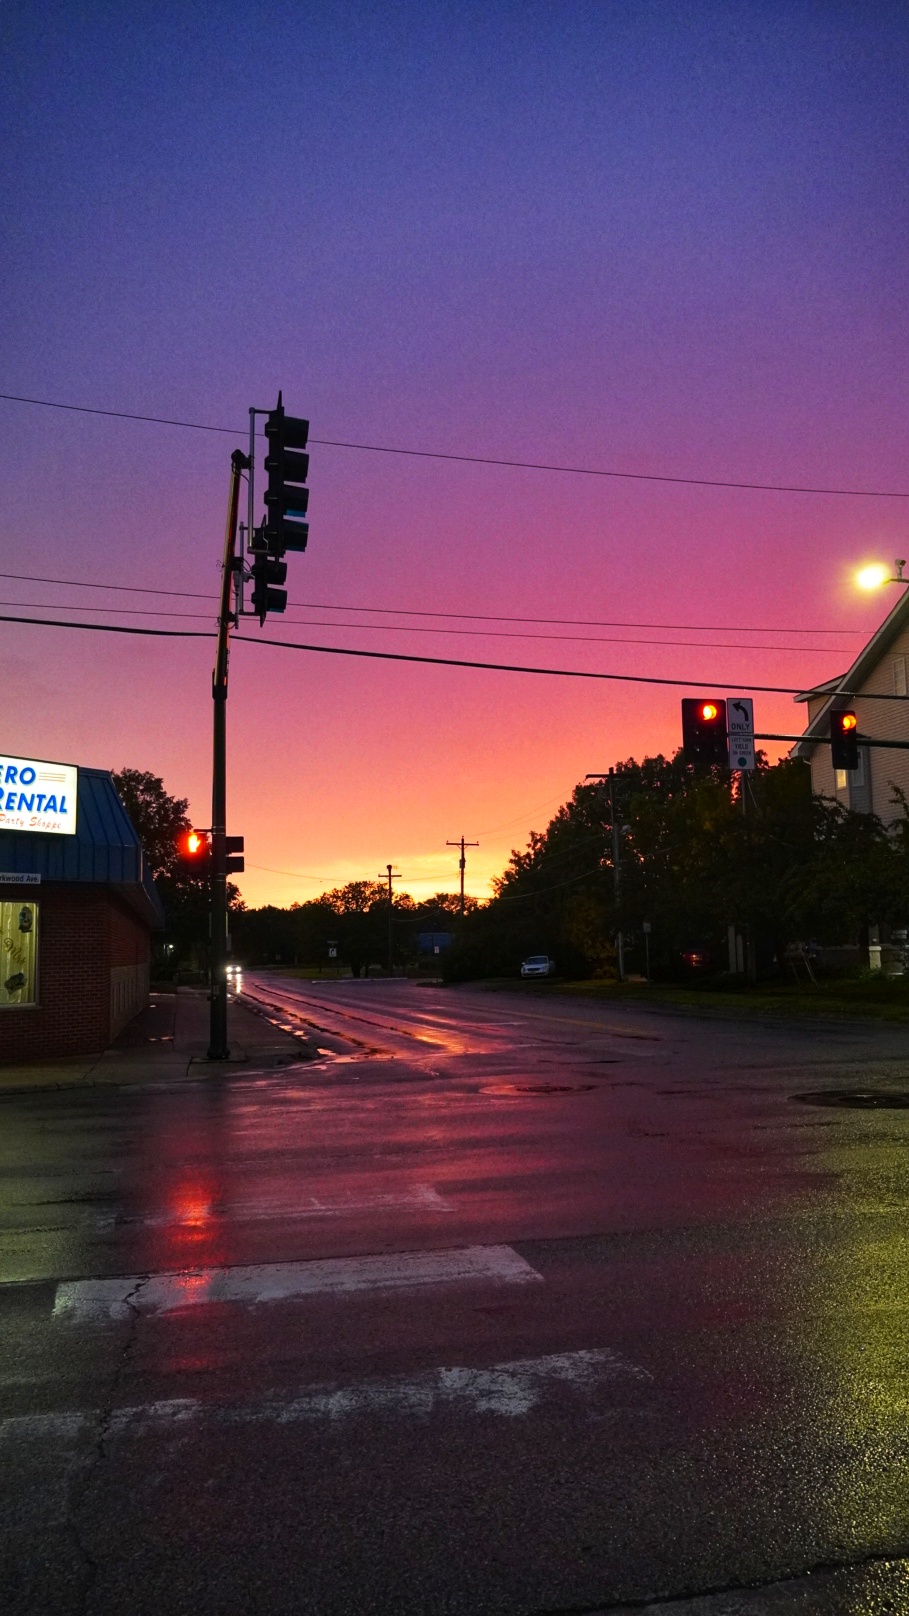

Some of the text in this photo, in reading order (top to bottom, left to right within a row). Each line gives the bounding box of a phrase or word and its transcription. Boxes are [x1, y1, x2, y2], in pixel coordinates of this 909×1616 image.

[731, 722, 750, 730] ONLY
[0, 764, 36, 785] RO
[29, 816, 61, 830] Shoppe
[26, 874, 38, 883] Ave
